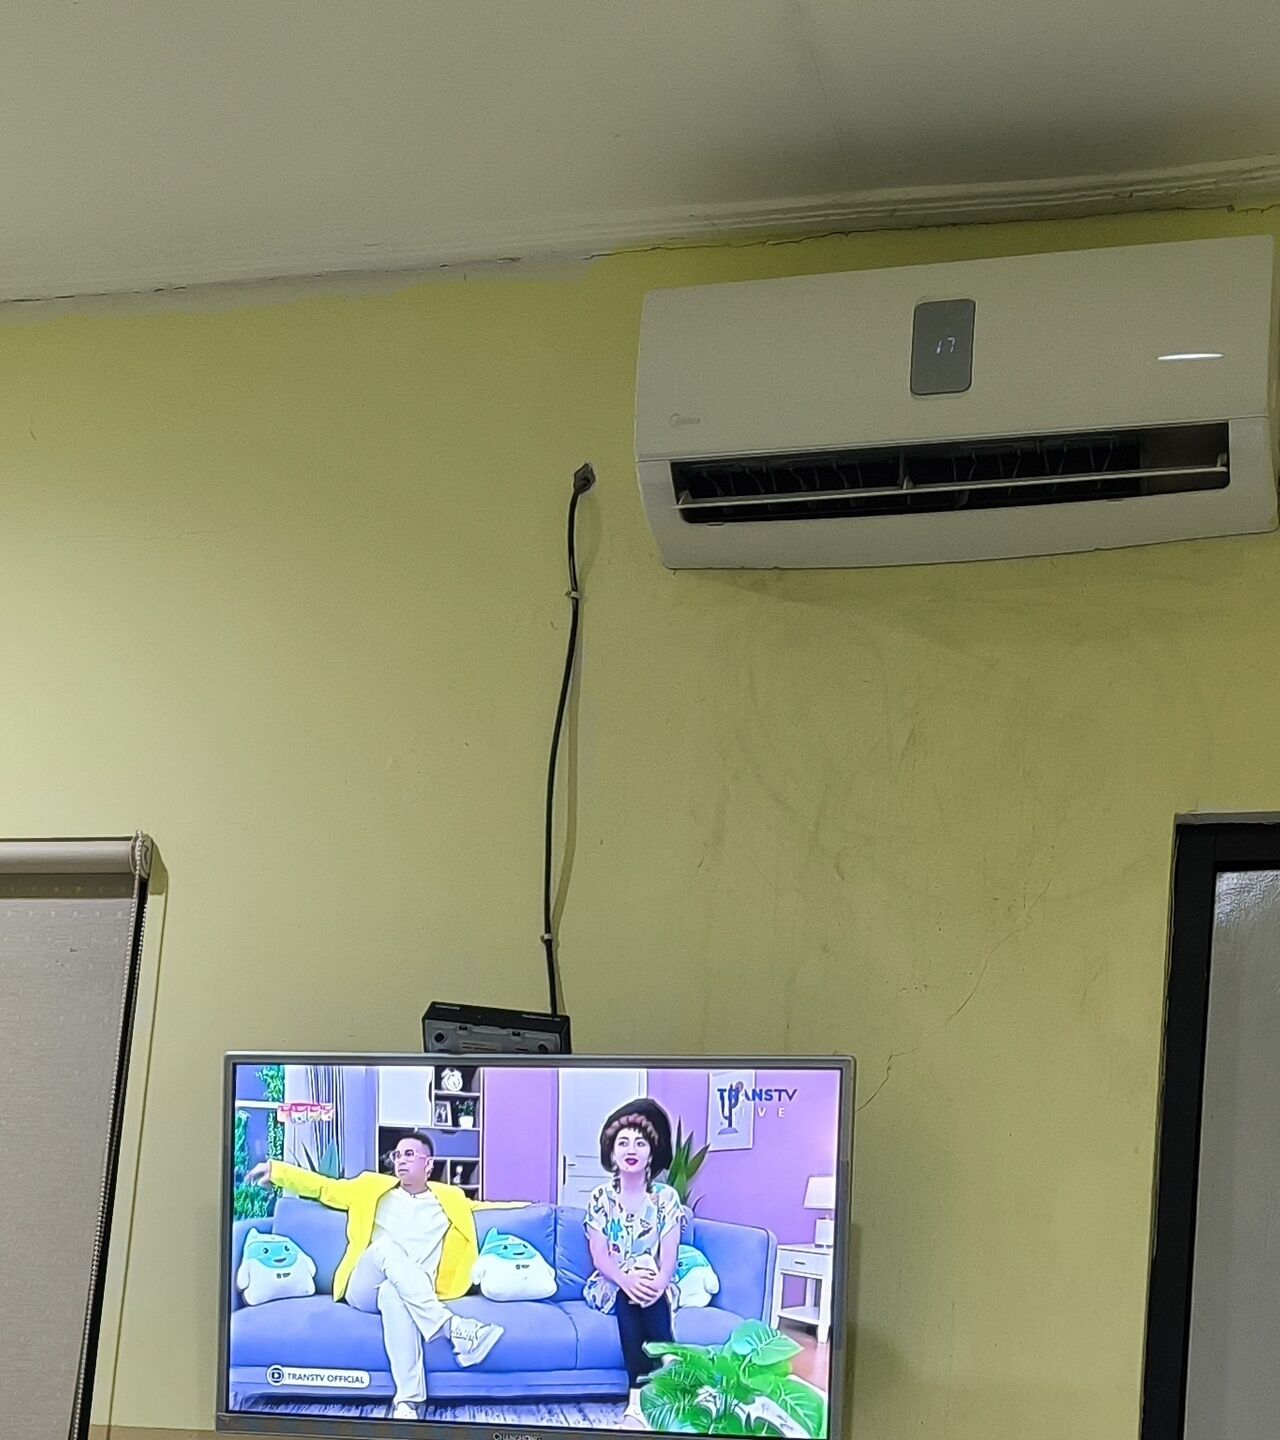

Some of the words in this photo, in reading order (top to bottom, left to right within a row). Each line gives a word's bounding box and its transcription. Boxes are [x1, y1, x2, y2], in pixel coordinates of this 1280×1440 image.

[936, 337, 956, 354] 17
[287, 1373, 325, 1382] TRANSTV
[327, 1374, 365, 1384] OFFICIAL
